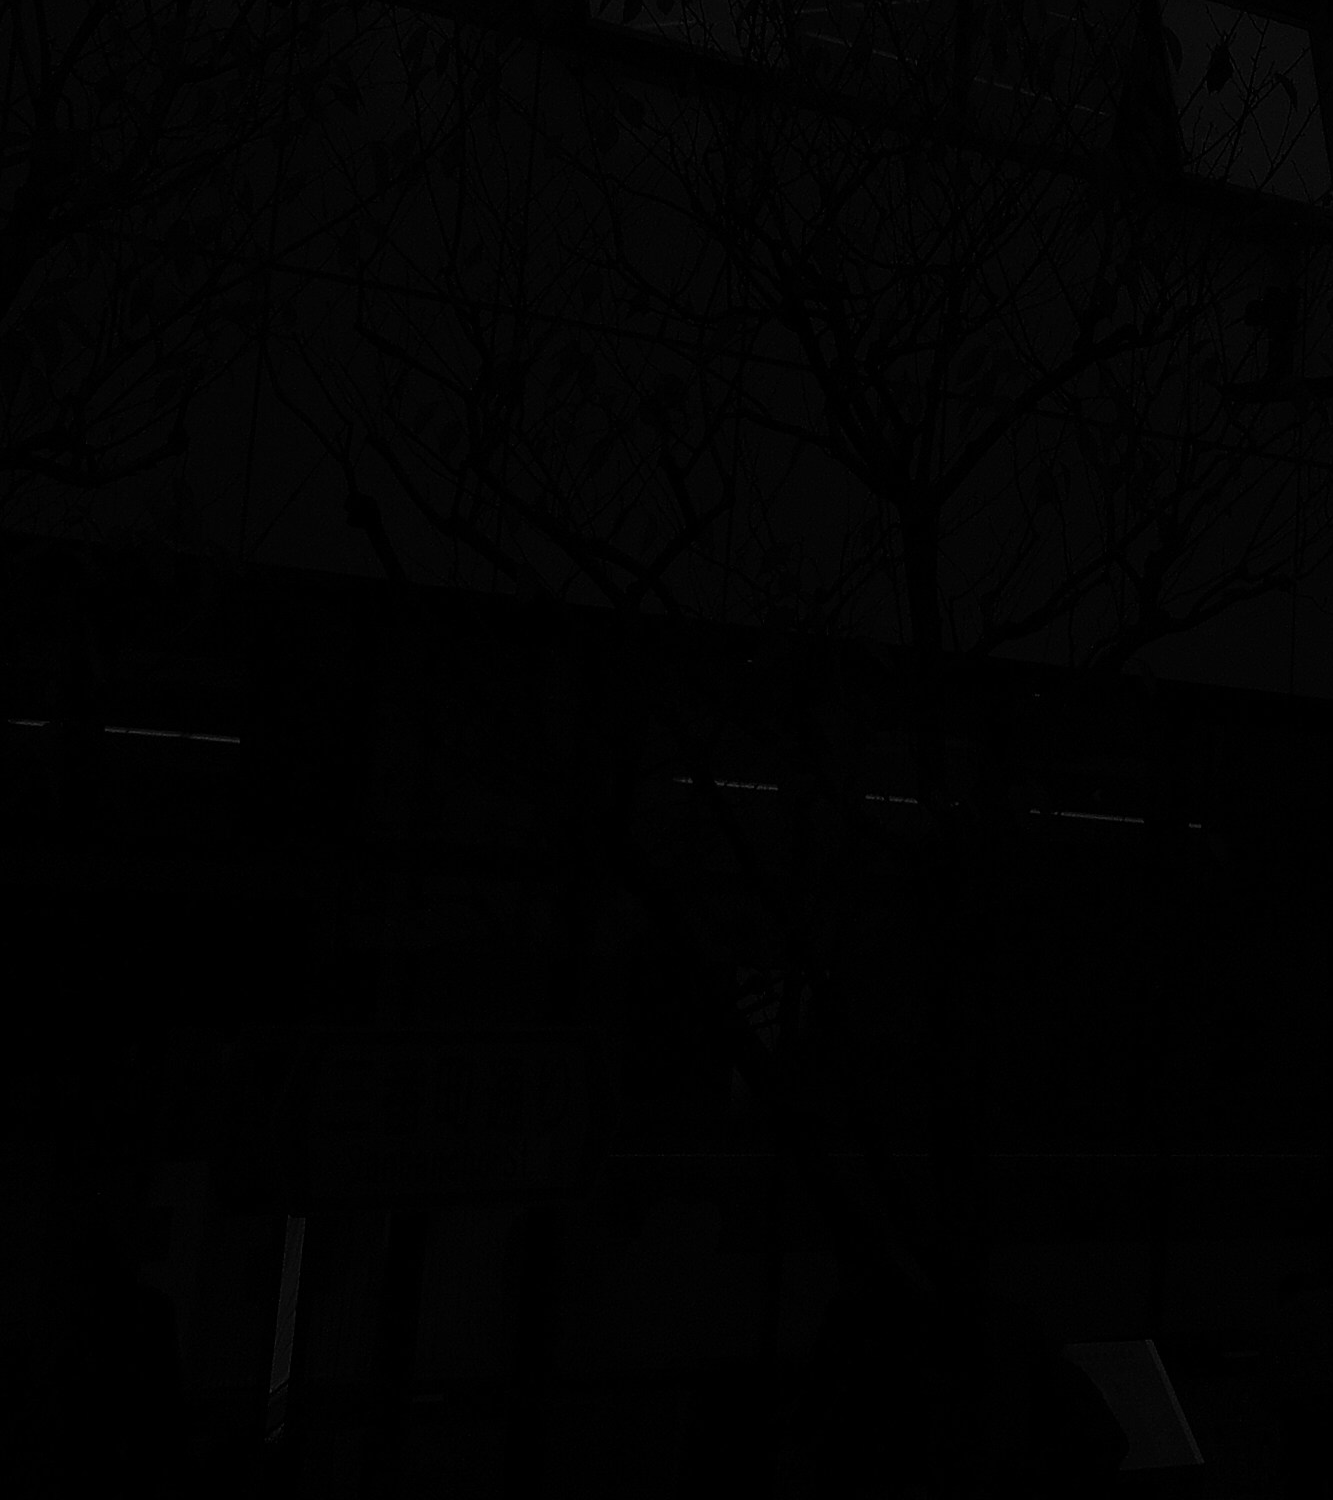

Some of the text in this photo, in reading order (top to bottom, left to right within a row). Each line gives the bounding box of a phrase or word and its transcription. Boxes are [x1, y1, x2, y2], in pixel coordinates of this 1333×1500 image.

[322, 1054, 572, 1136] 三番町通り
